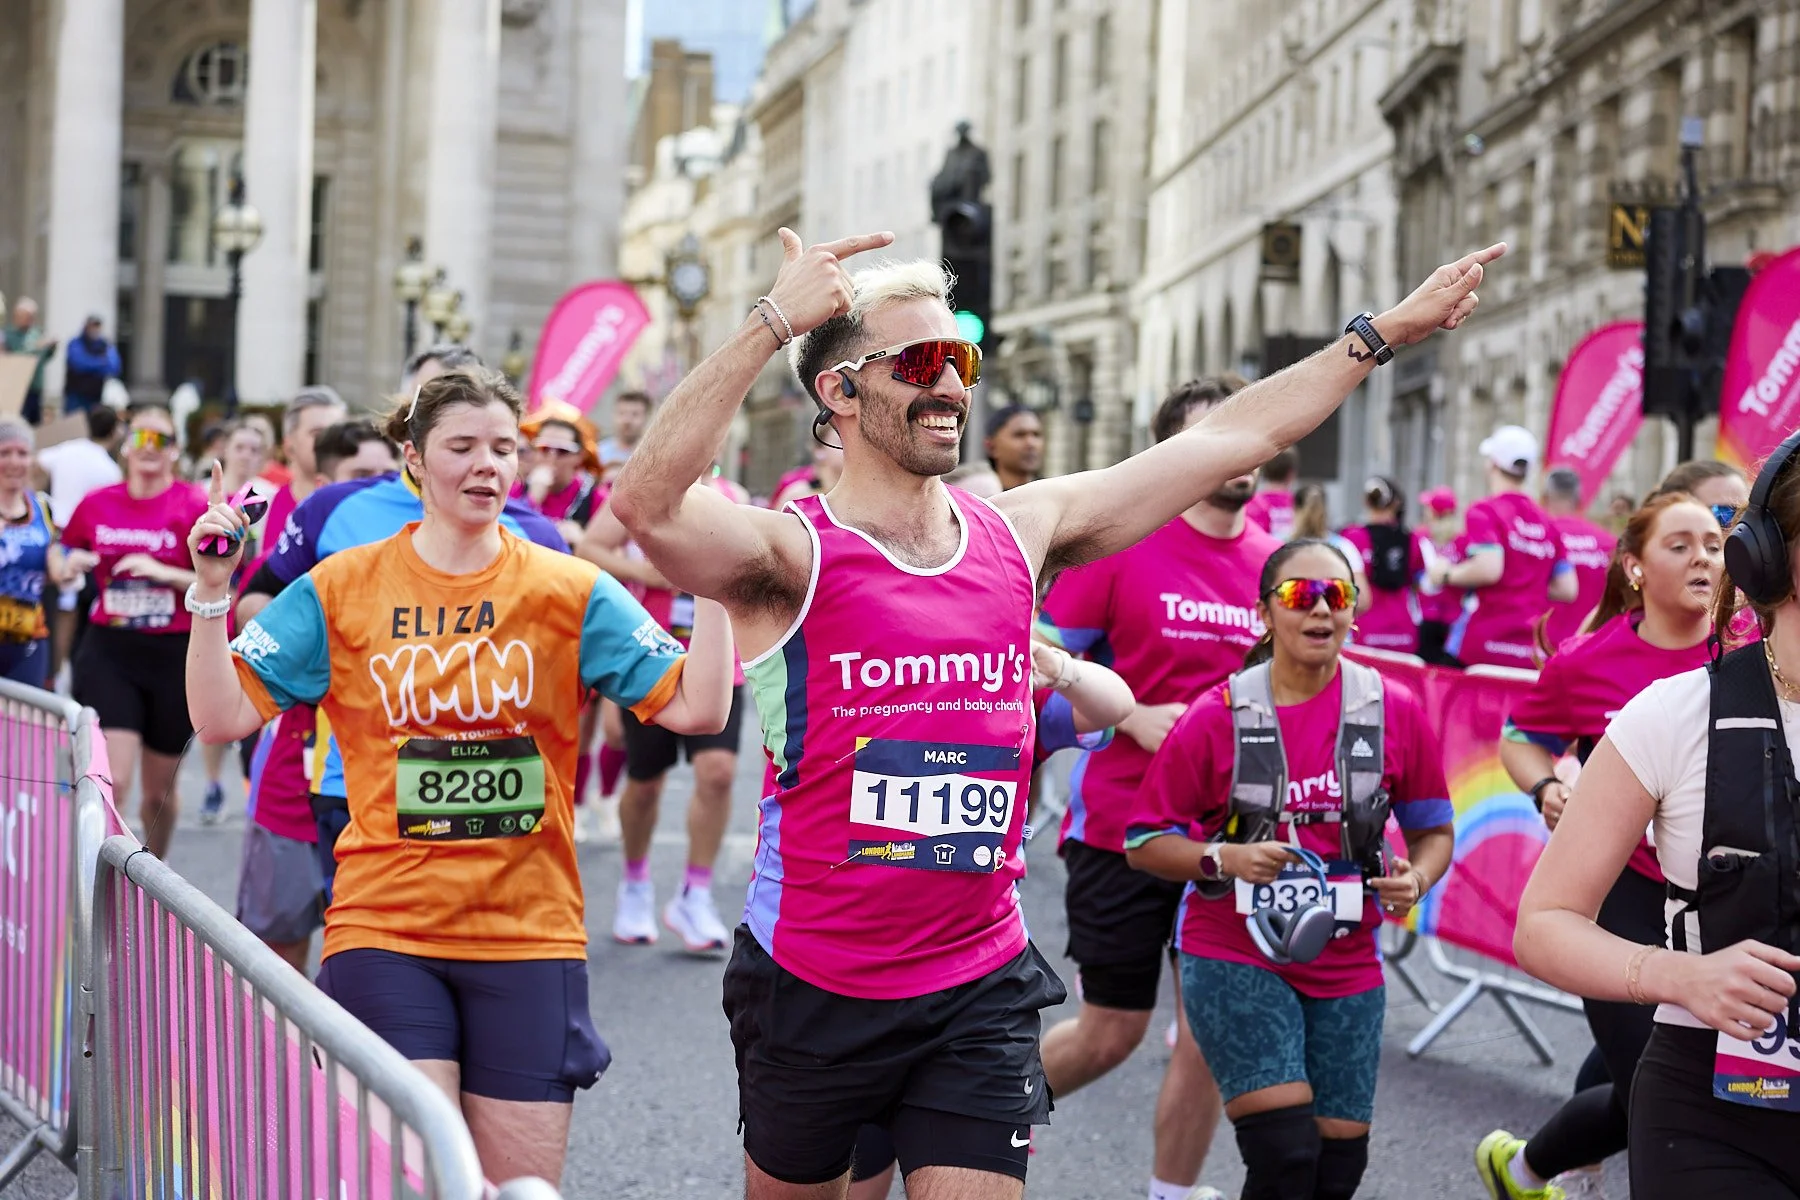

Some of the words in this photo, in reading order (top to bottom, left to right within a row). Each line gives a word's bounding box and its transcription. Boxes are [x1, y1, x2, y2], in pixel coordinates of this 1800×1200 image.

[95, 524, 177, 552] Tommy's
[391, 601, 495, 639] ELIZA
[369, 636, 534, 727] YMM
[829, 644, 1025, 693] Tommy's
[832, 705, 856, 718] The
[860, 701, 933, 718] pregnancy
[937, 698, 961, 711] and
[964, 697, 993, 714] baby
[459, 726, 503, 740] YOUNG
[451, 746, 490, 757] ELIZA
[924, 750, 968, 765] MARC
[418, 768, 524, 804] 8280
[867, 779, 1009, 828] 11199
